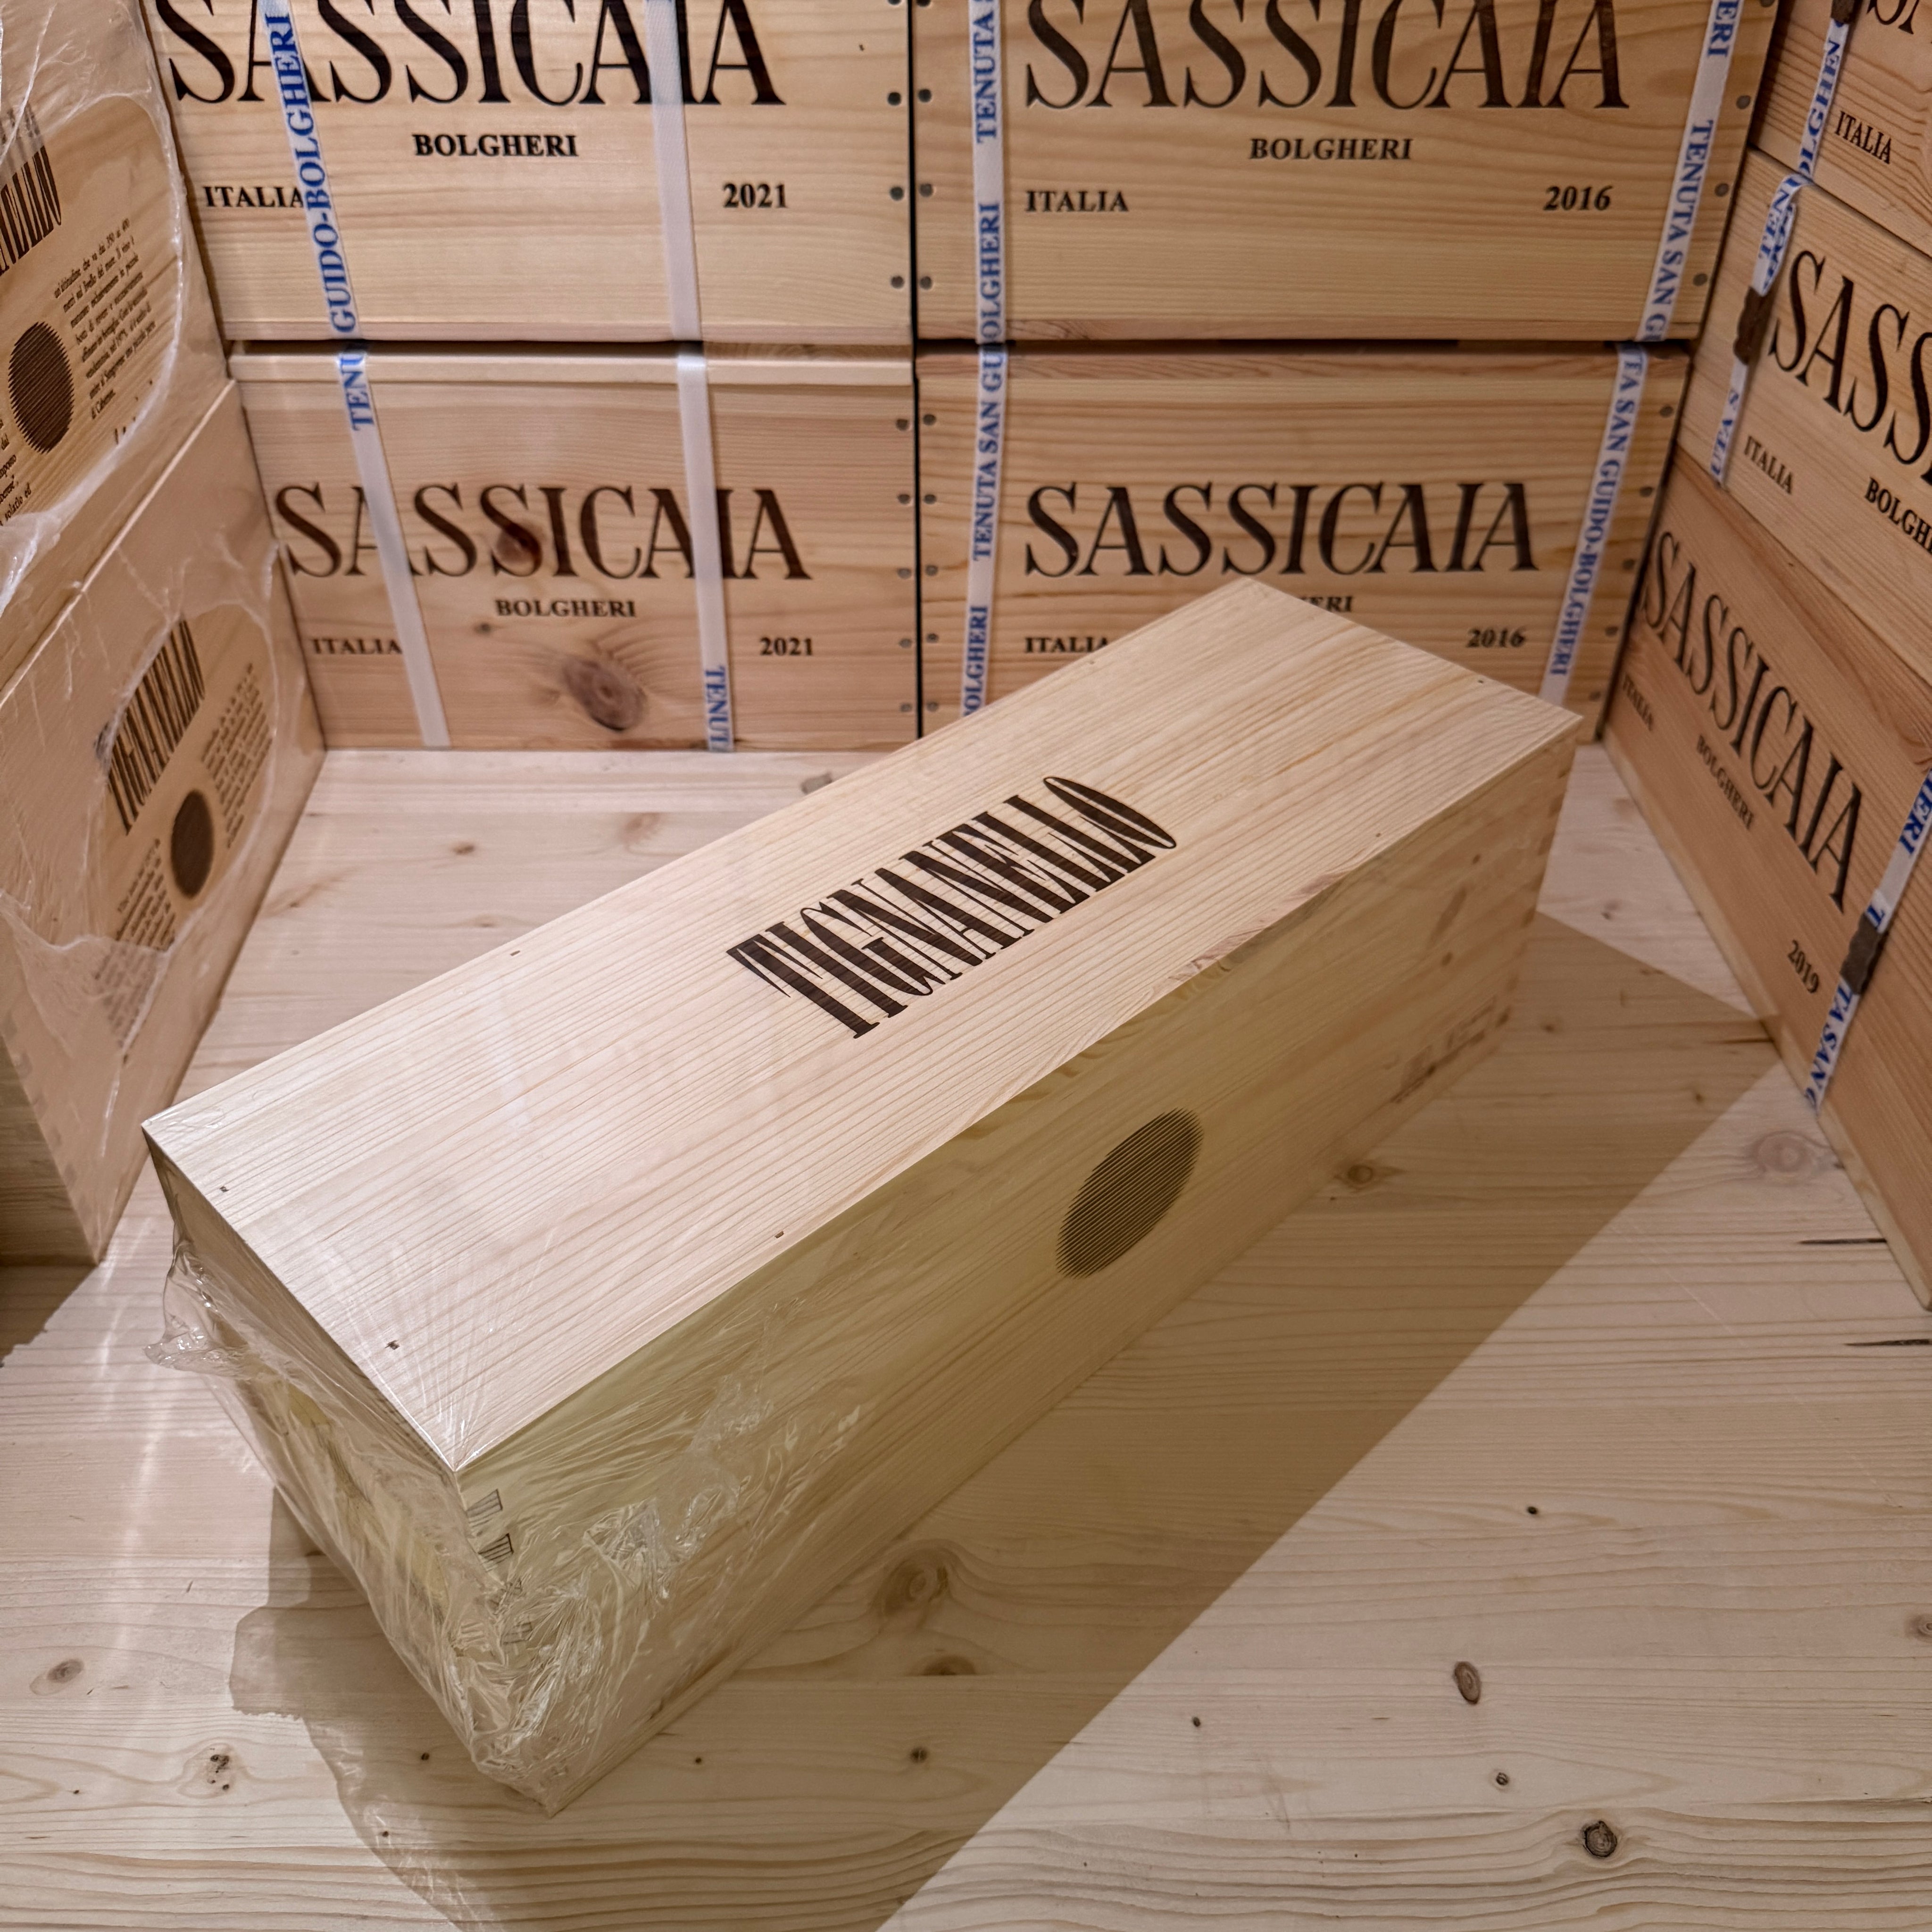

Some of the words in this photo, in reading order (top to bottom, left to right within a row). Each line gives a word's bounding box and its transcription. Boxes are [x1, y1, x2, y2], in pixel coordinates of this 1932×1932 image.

[972, 10, 997, 143] TENUTA
[1026, 0, 1629, 109] SASSICAIA
[412, 134, 579, 157] BOLGHERI
[1249, 138, 1414, 160] BOLGHERI
[1834, 110, 1892, 165] ITALIA
[204, 186, 305, 208] ITALIA
[723, 183, 789, 208] 2021
[1025, 191, 1129, 212] ITALIA
[1543, 186, 1613, 211] 2016
[1667, 120, 1714, 242] TENUTA
[1651, 250, 1683, 307] SAN
[1768, 250, 1932, 485] SASS
[978, 401, 999, 454] SAN
[1606, 400, 1635, 452] SAN
[1745, 436, 1792, 494] ITALIA
[973, 461, 997, 561] TENUTA
[1025, 482, 1540, 576] SASSICAIA
[495, 600, 636, 617] BOLGHERI
[312, 638, 402, 655] ITALIA
[759, 637, 813, 656] 2021
[963, 606, 987, 716] OLGHERI
[1466, 627, 1527, 649] 2016
[705, 666, 730, 751] TENUT
[1643, 532, 1862, 914] SASSICAIA
[1697, 734, 1755, 830] BOLGHERI
[725, 775, 1177, 1039] TIGNANELLO
[1788, 939, 1820, 994] 2019
